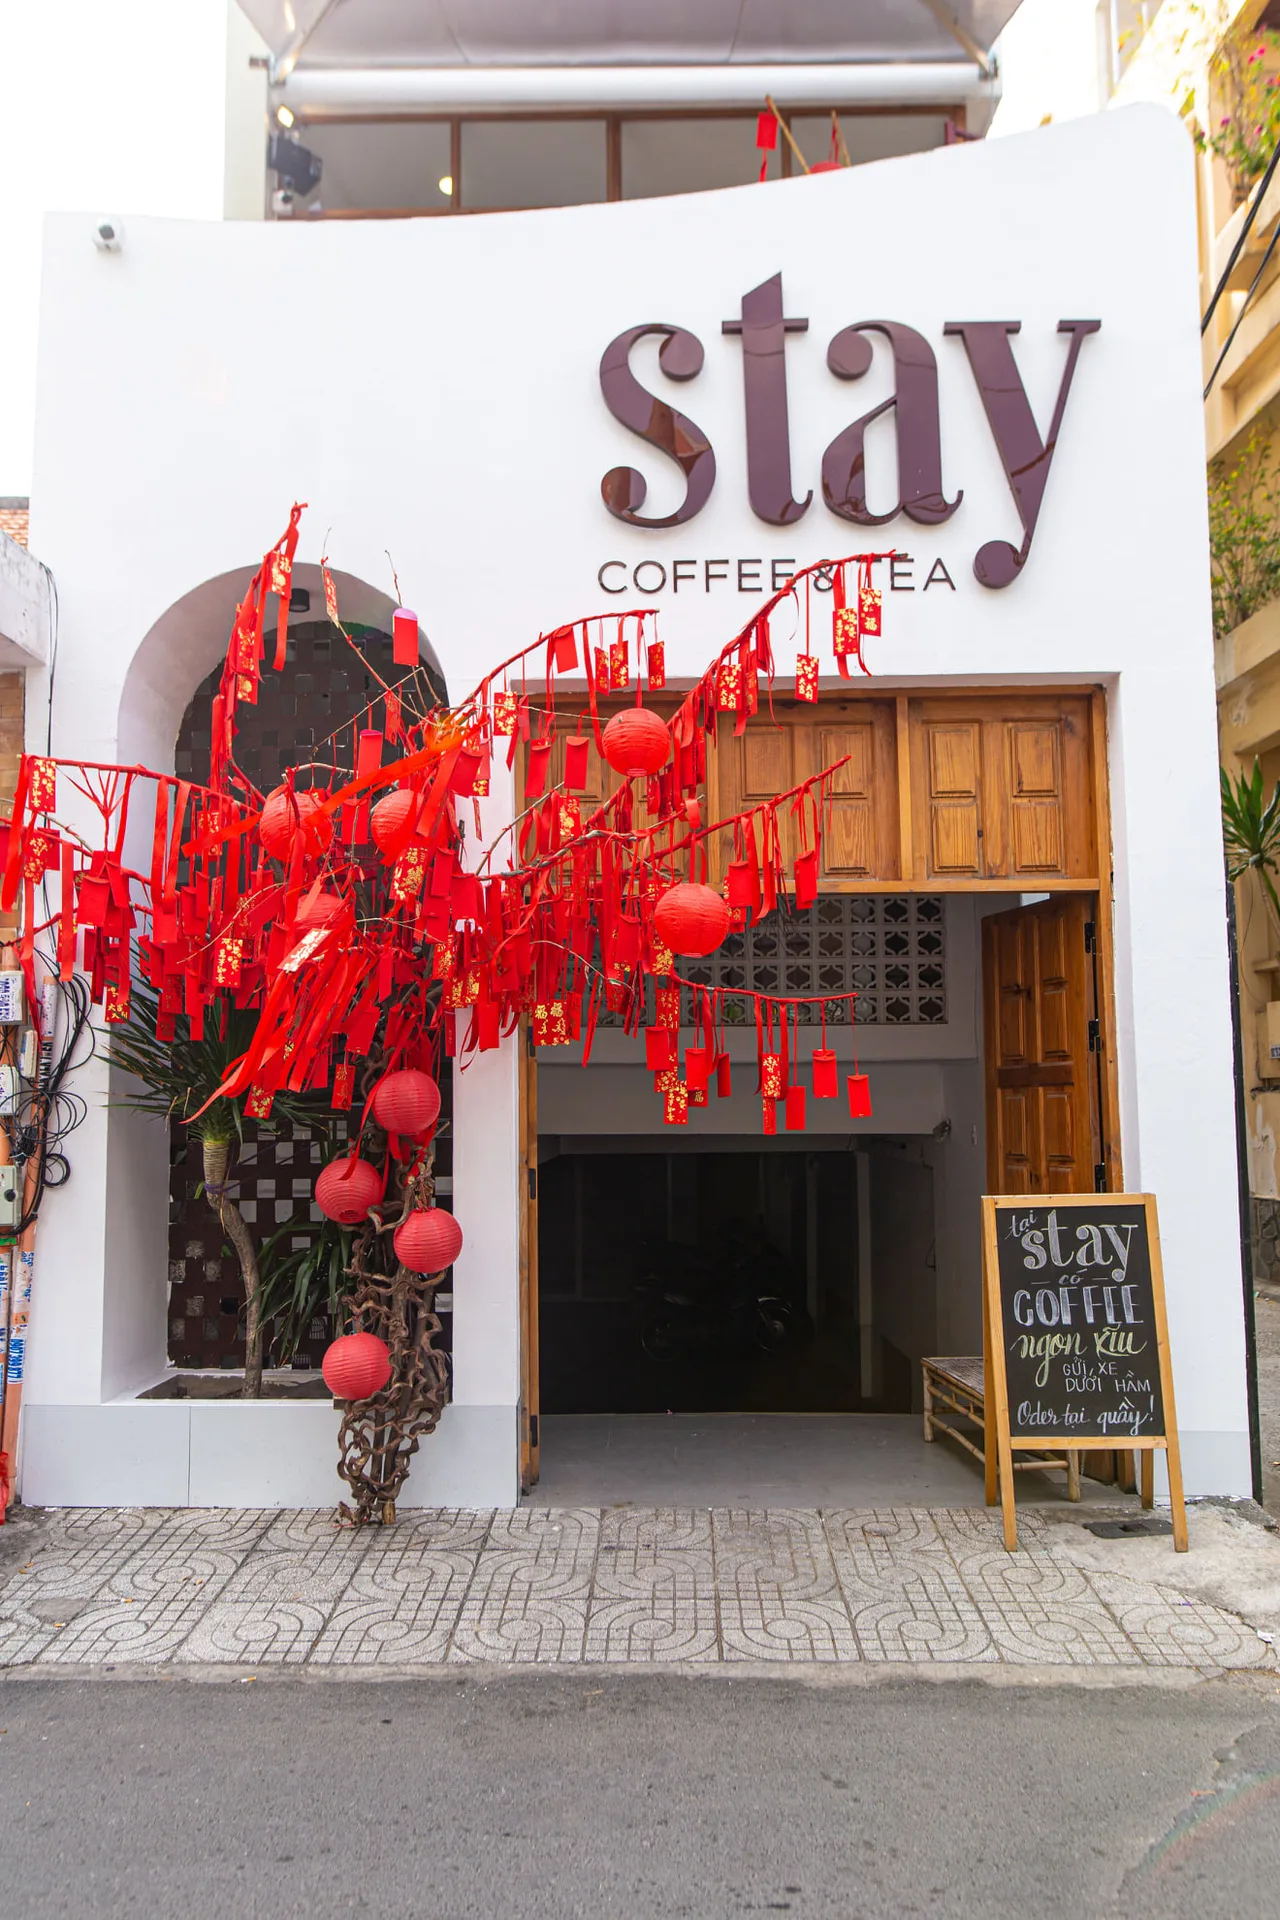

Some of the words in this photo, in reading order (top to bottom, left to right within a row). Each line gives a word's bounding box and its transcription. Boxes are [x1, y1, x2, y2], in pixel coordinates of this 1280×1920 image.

[599, 271, 1101, 589] stay
[597, 558, 797, 593] COFFEE
[856, 556, 956, 592] EA
[1021, 1209, 1139, 1282] stay
[1013, 1284, 1144, 1327] COFFEE
[1010, 1332, 1087, 1388] ngon
[1098, 1361, 1118, 1375] XE
[1114, 1369, 1151, 1392] HẦM
[1017, 1400, 1060, 1426] Oder
[1061, 1403, 1090, 1429] tại
